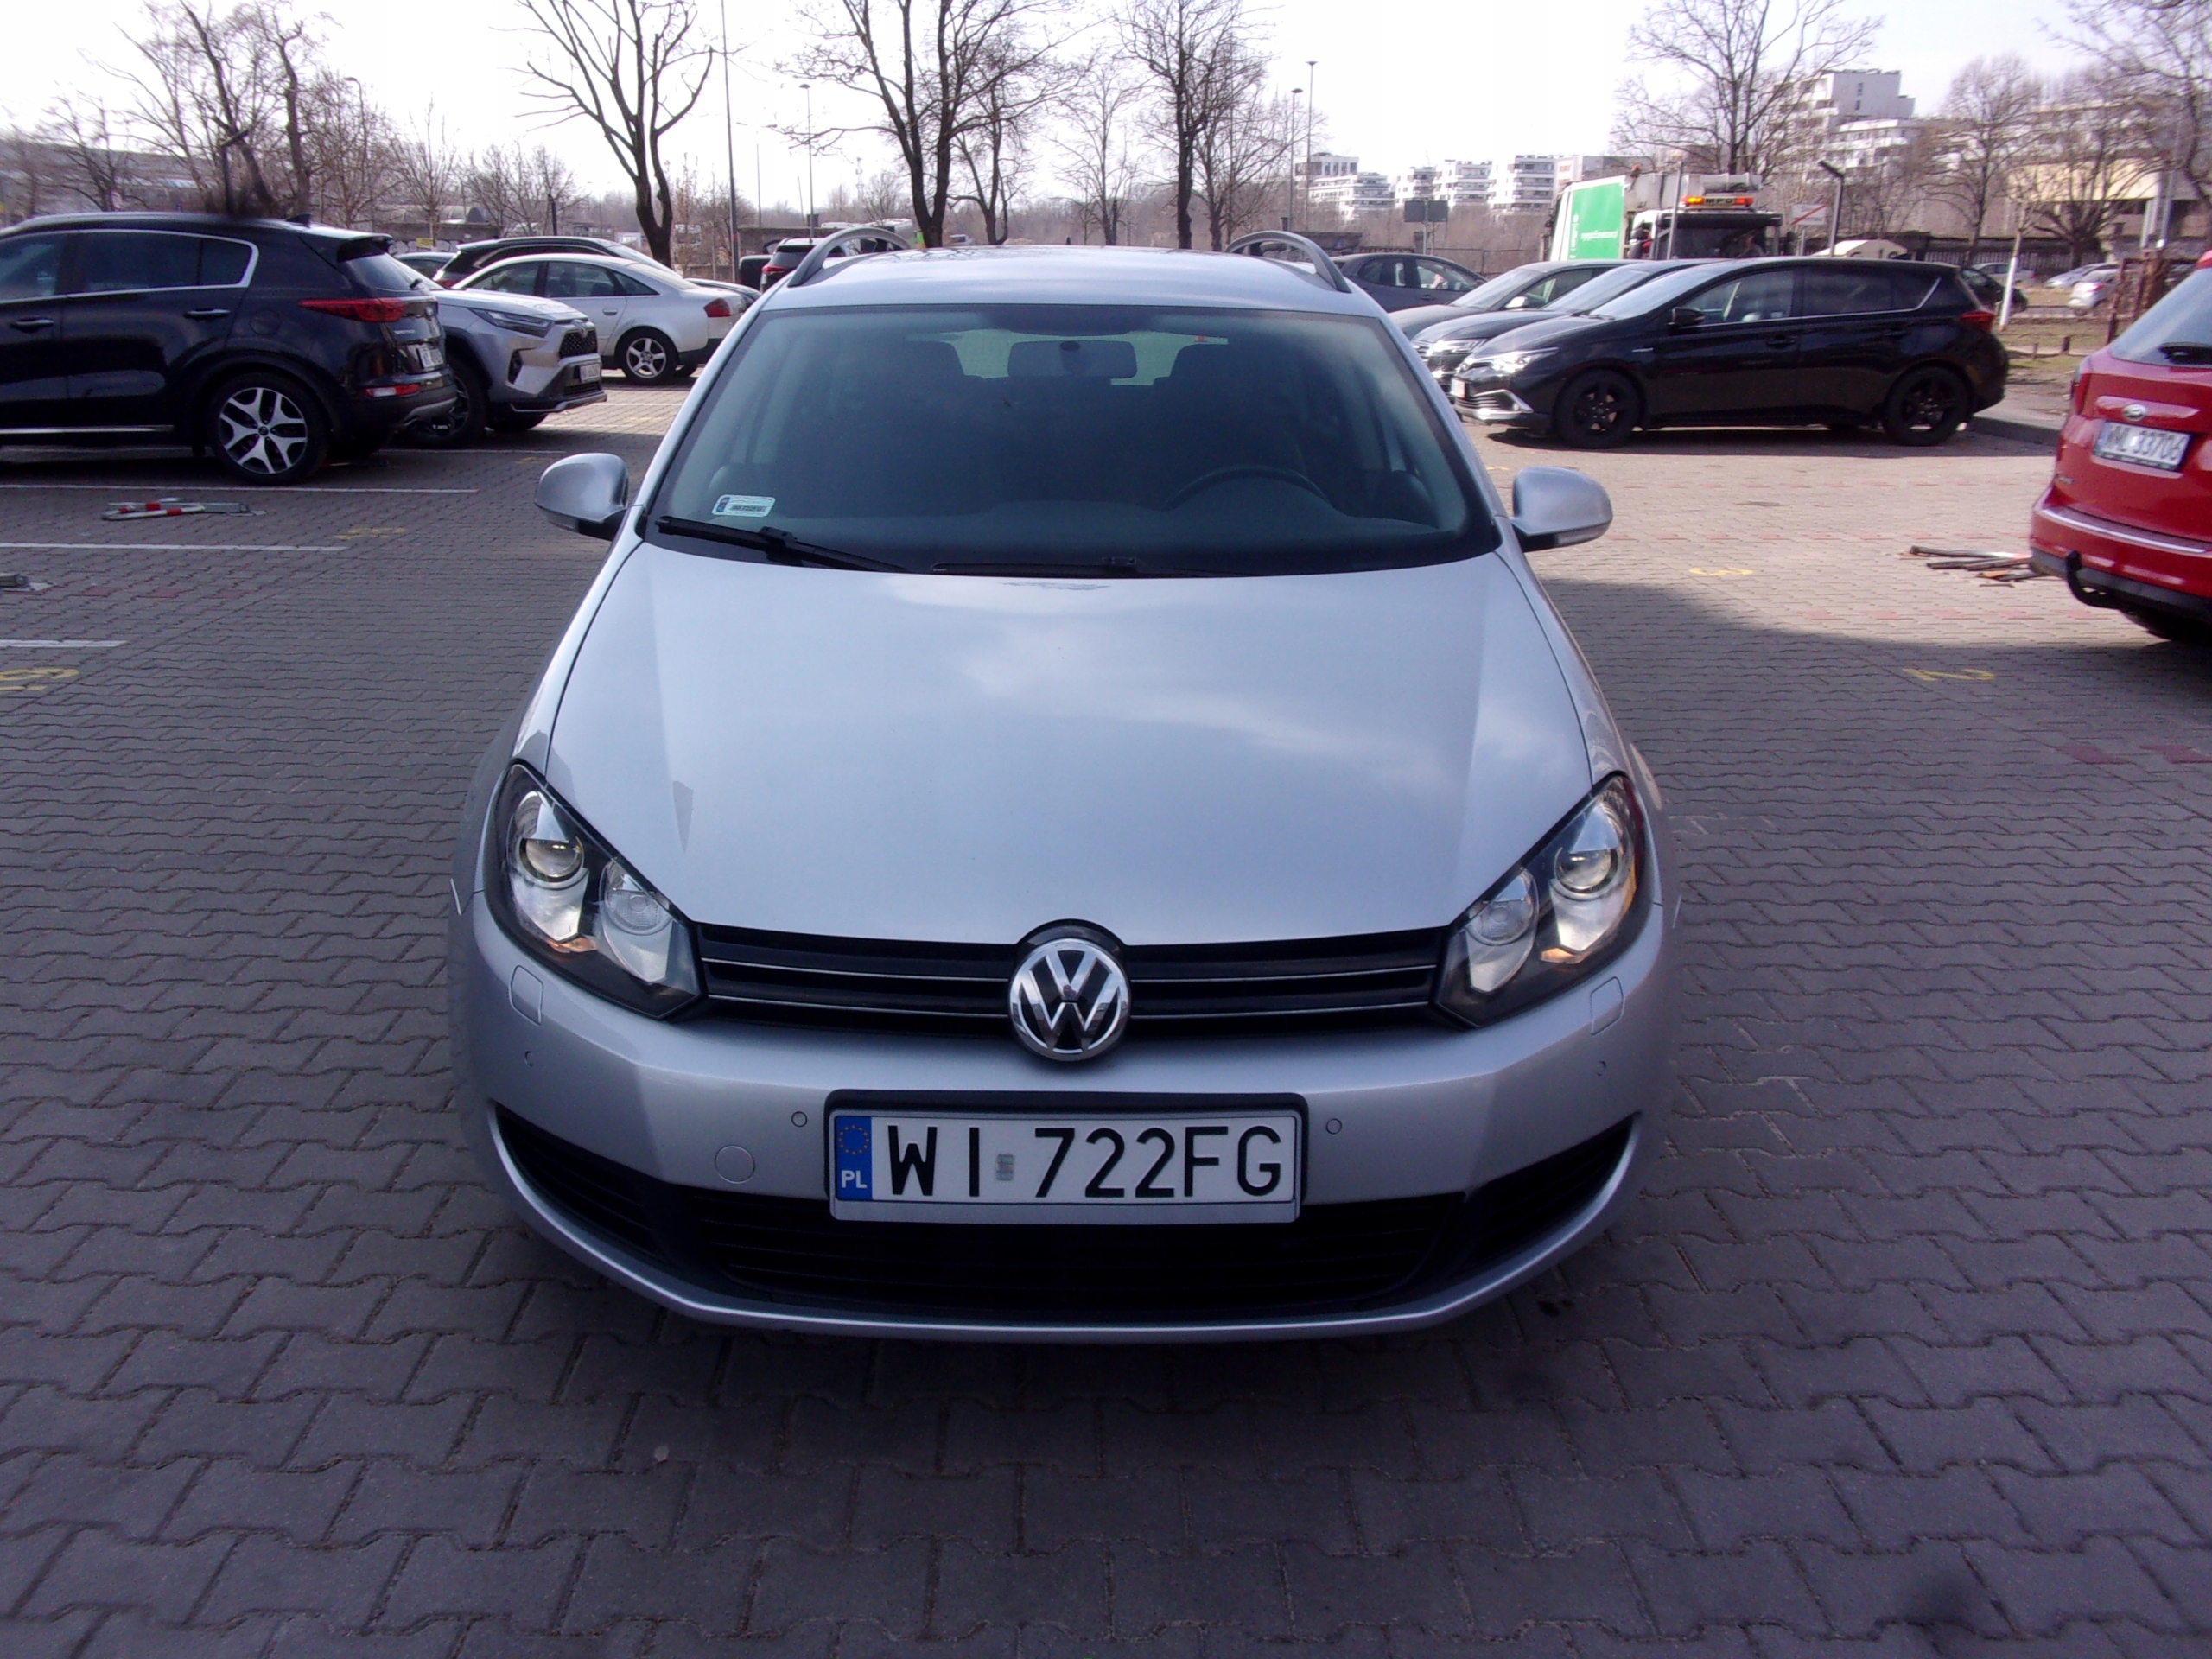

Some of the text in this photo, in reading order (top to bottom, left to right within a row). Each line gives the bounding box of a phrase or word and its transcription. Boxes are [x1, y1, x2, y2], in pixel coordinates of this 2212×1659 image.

[842, 1170, 868, 1189] PL
[888, 1125, 1281, 1198] WI 722FG
